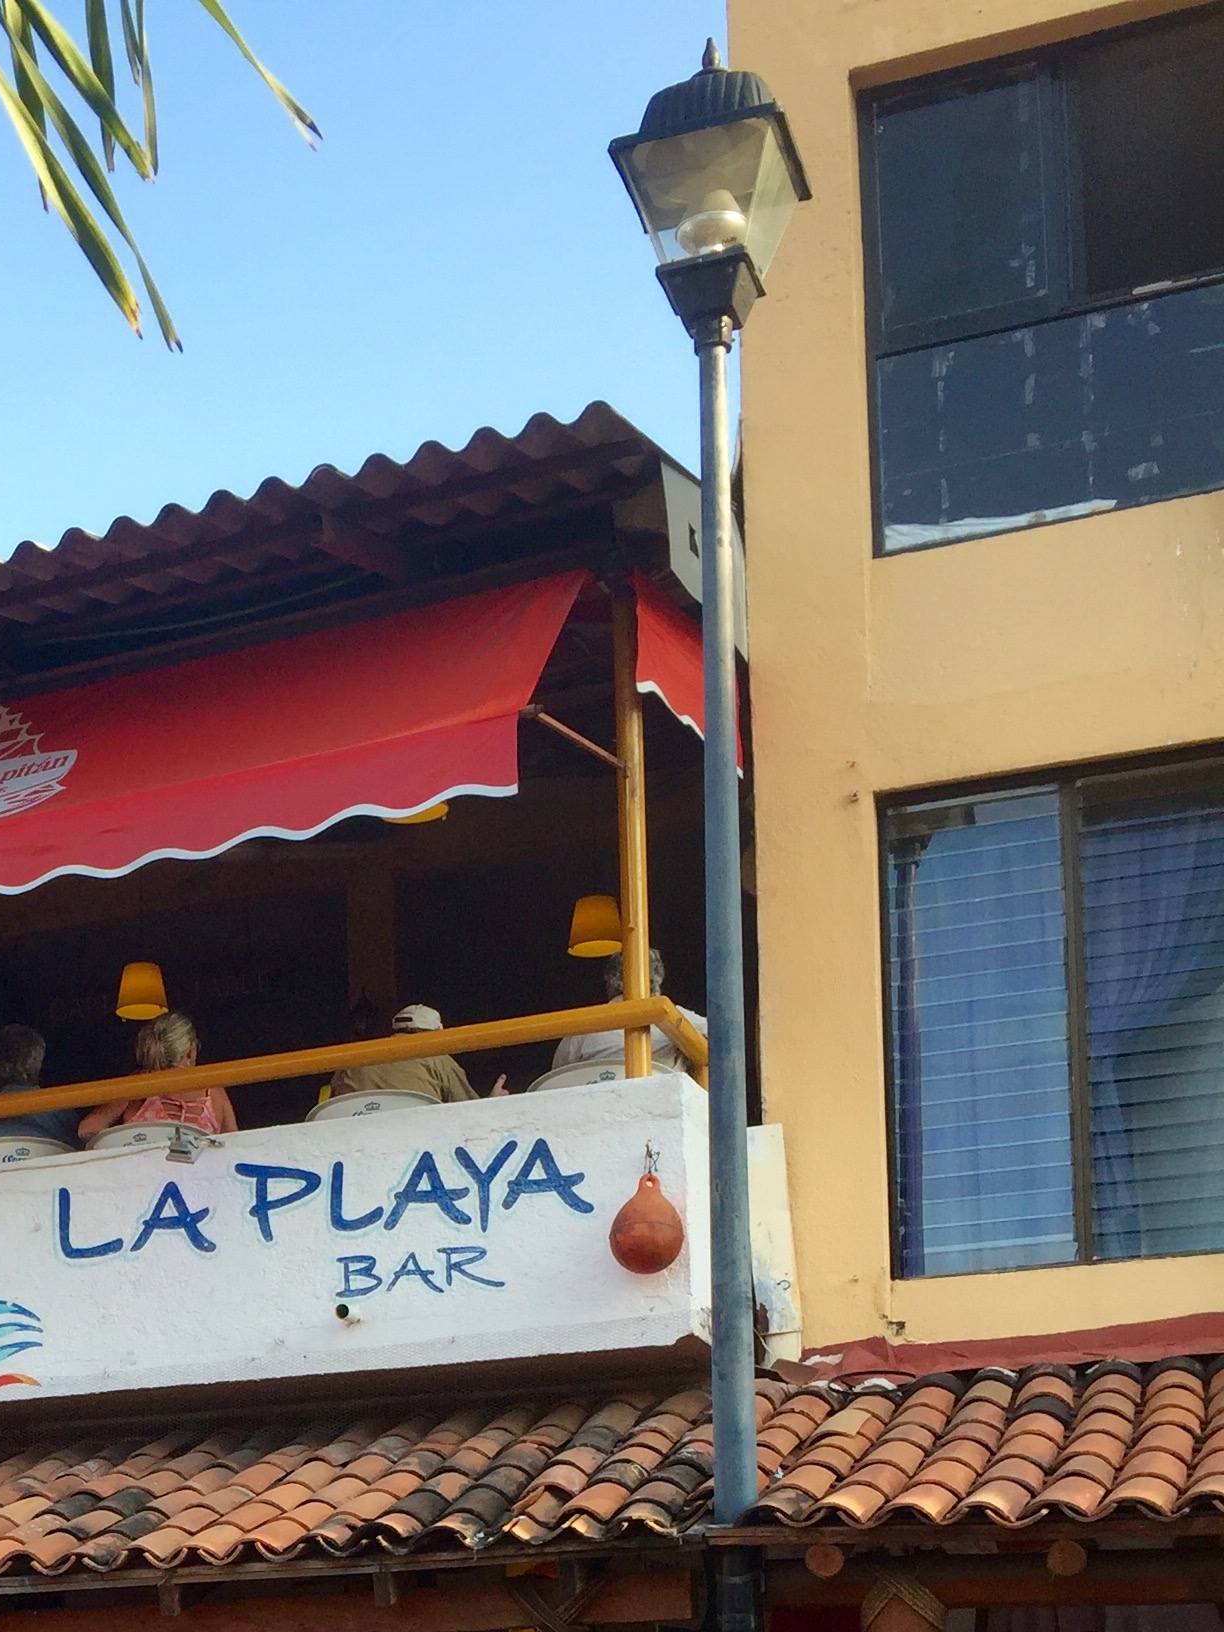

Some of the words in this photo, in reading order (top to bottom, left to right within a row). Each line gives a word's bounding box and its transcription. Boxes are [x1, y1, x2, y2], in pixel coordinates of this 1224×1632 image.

[58, 1180, 217, 1260] LA
[234, 1137, 594, 1243] PLAYA
[336, 1246, 506, 1299] BAR
